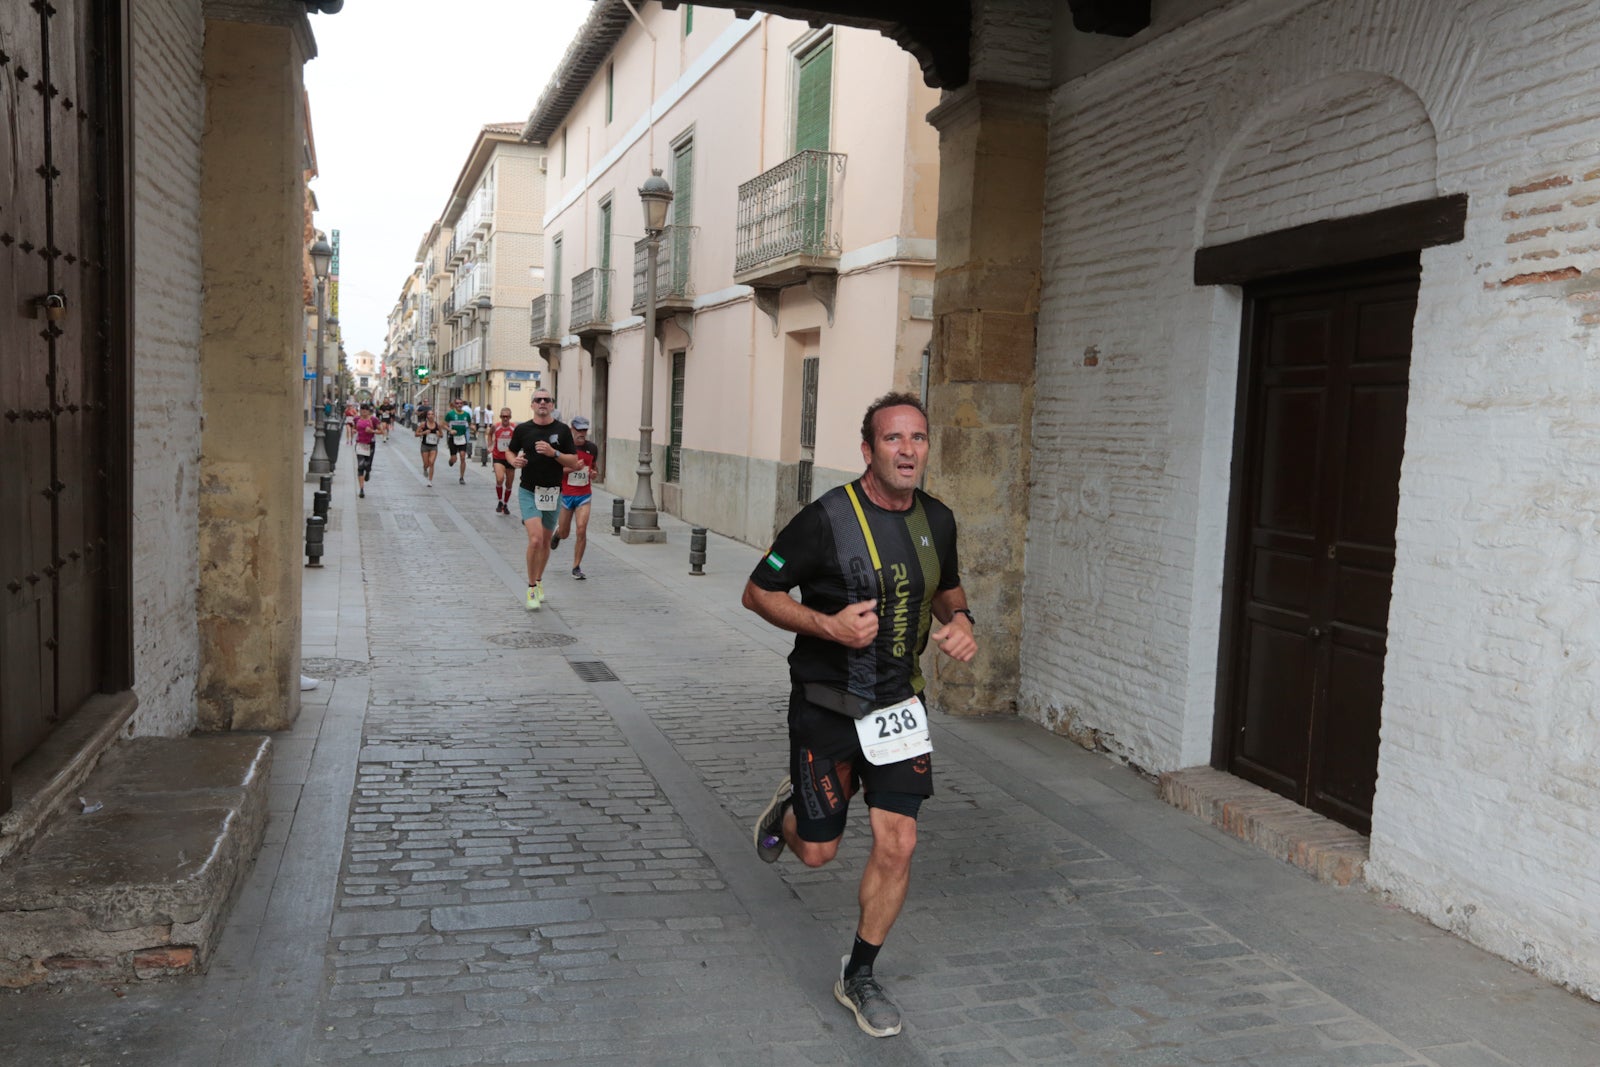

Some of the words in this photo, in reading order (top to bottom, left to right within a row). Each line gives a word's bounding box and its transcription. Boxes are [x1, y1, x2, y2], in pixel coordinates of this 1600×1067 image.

[574, 472, 586, 480] 793
[539, 494, 554, 503] 201
[891, 562, 911, 658] RUNNING
[875, 708, 917, 739] 238
